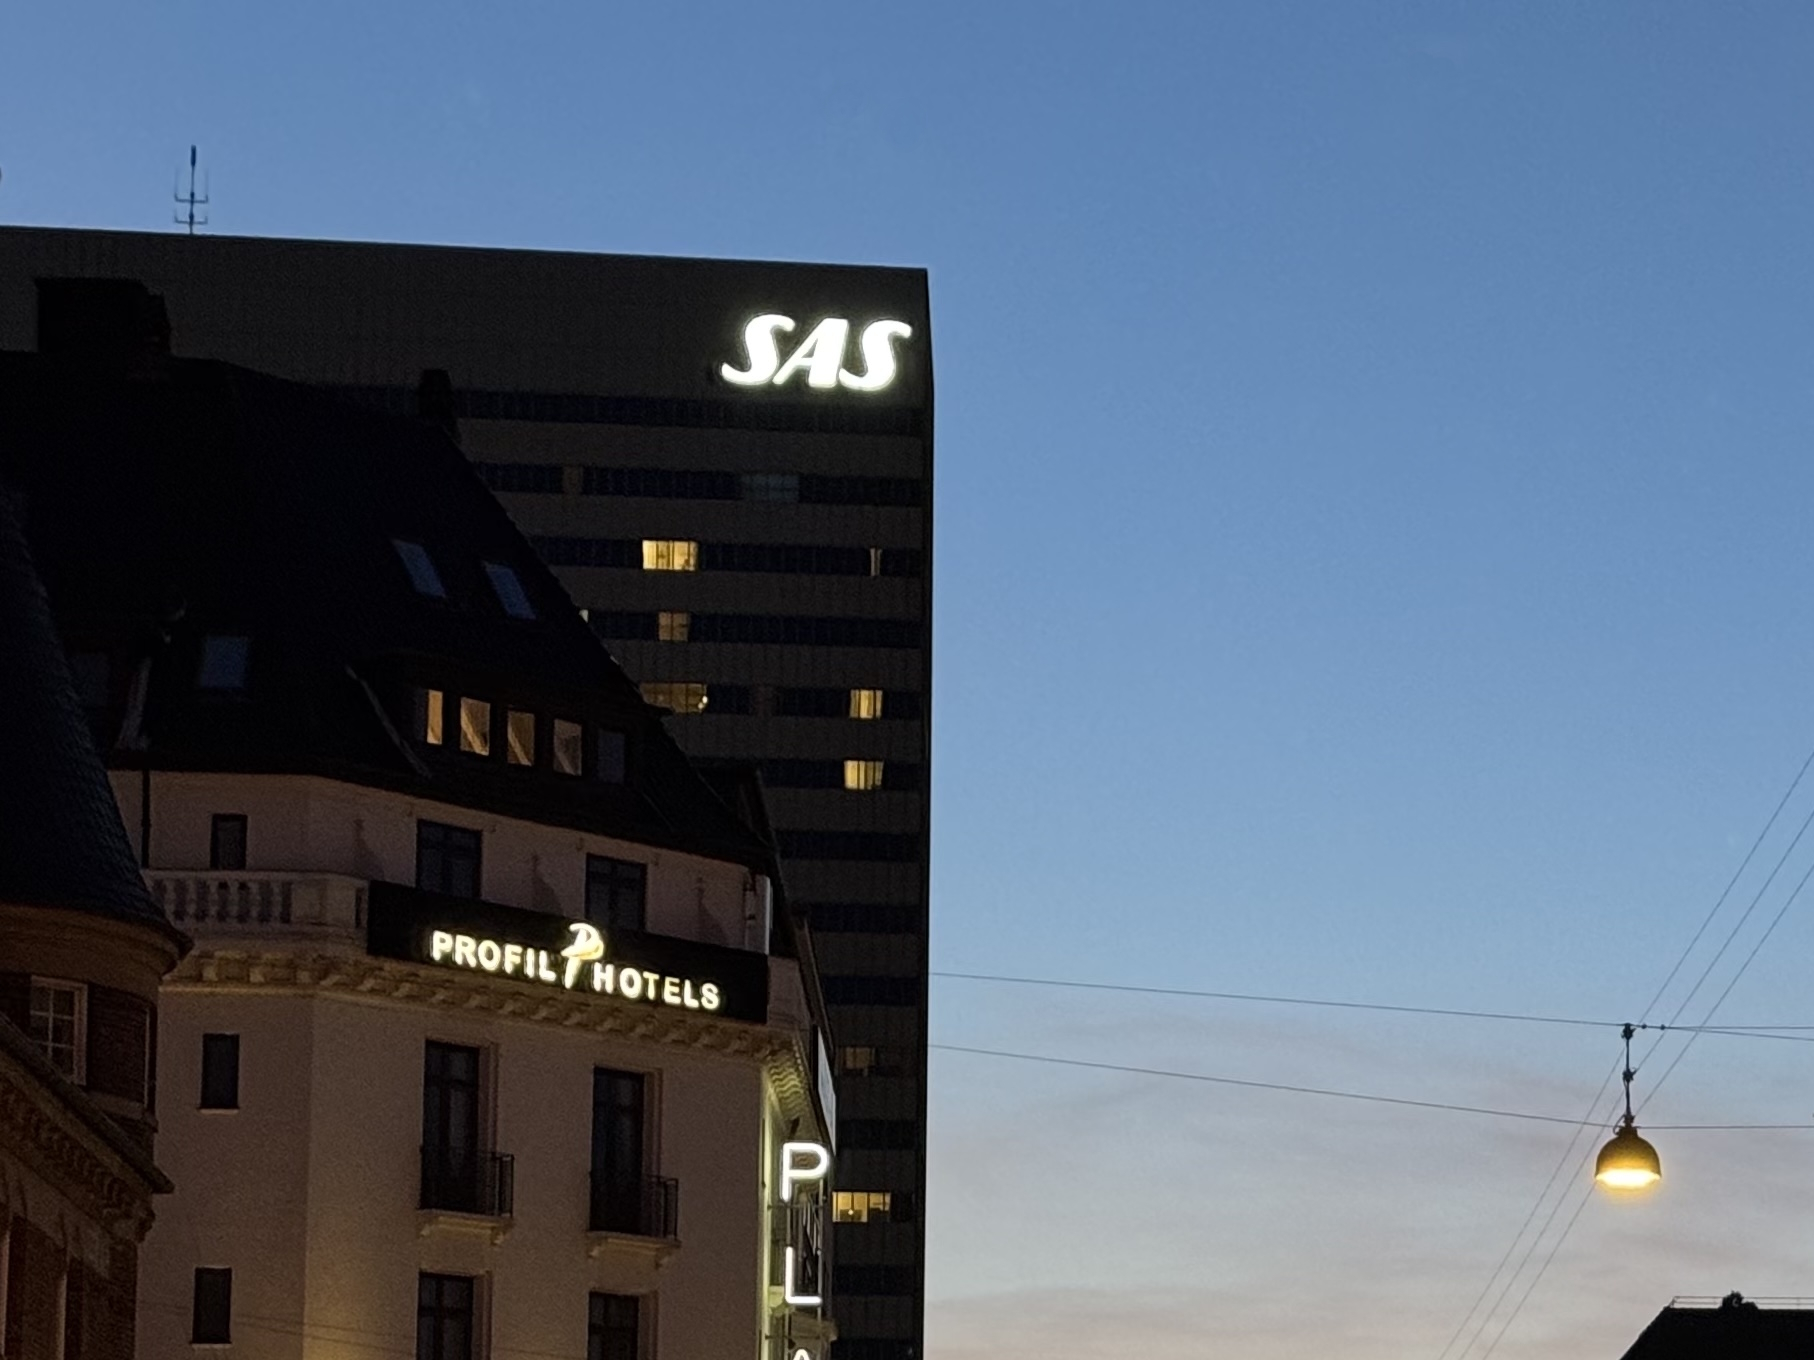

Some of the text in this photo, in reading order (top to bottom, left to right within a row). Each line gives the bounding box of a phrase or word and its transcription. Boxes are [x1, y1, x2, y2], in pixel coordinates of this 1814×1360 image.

[721, 314, 912, 391] SAS
[430, 930, 556, 982] PROFIL
[592, 961, 721, 1010] HOTELS
